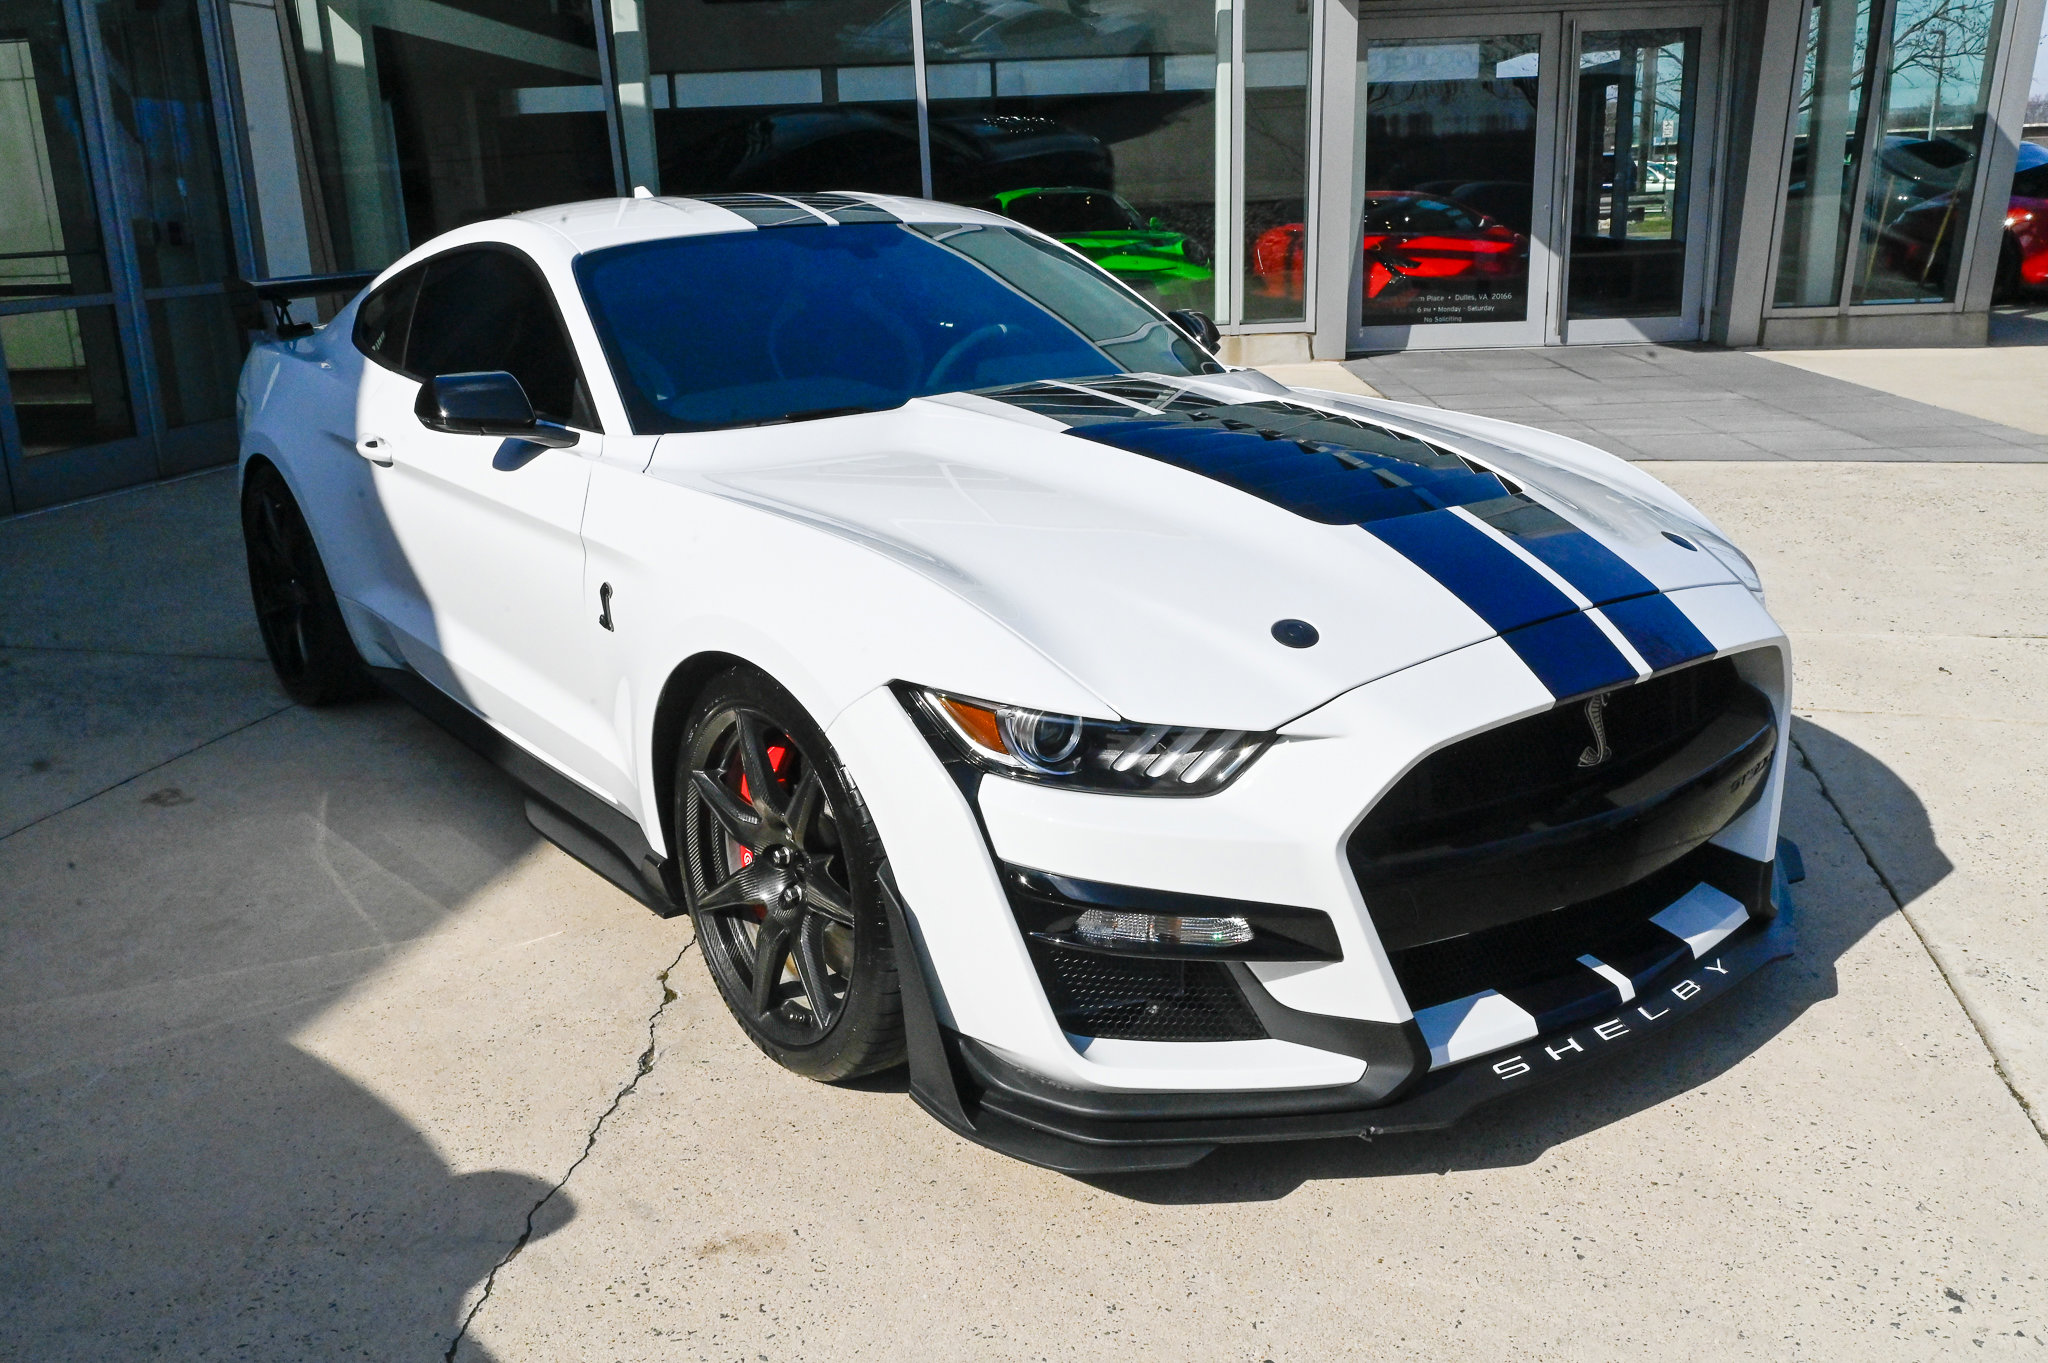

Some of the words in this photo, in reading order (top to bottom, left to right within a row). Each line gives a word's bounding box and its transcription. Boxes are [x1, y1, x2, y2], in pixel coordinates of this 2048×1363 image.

[1426, 294, 1445, 302] Place
[1454, 293, 1477, 301] Dulles,
[1491, 292, 1513, 300] 20166
[1434, 315, 1463, 323] Soliciting
[1492, 957, 1729, 1080] SHELBY
